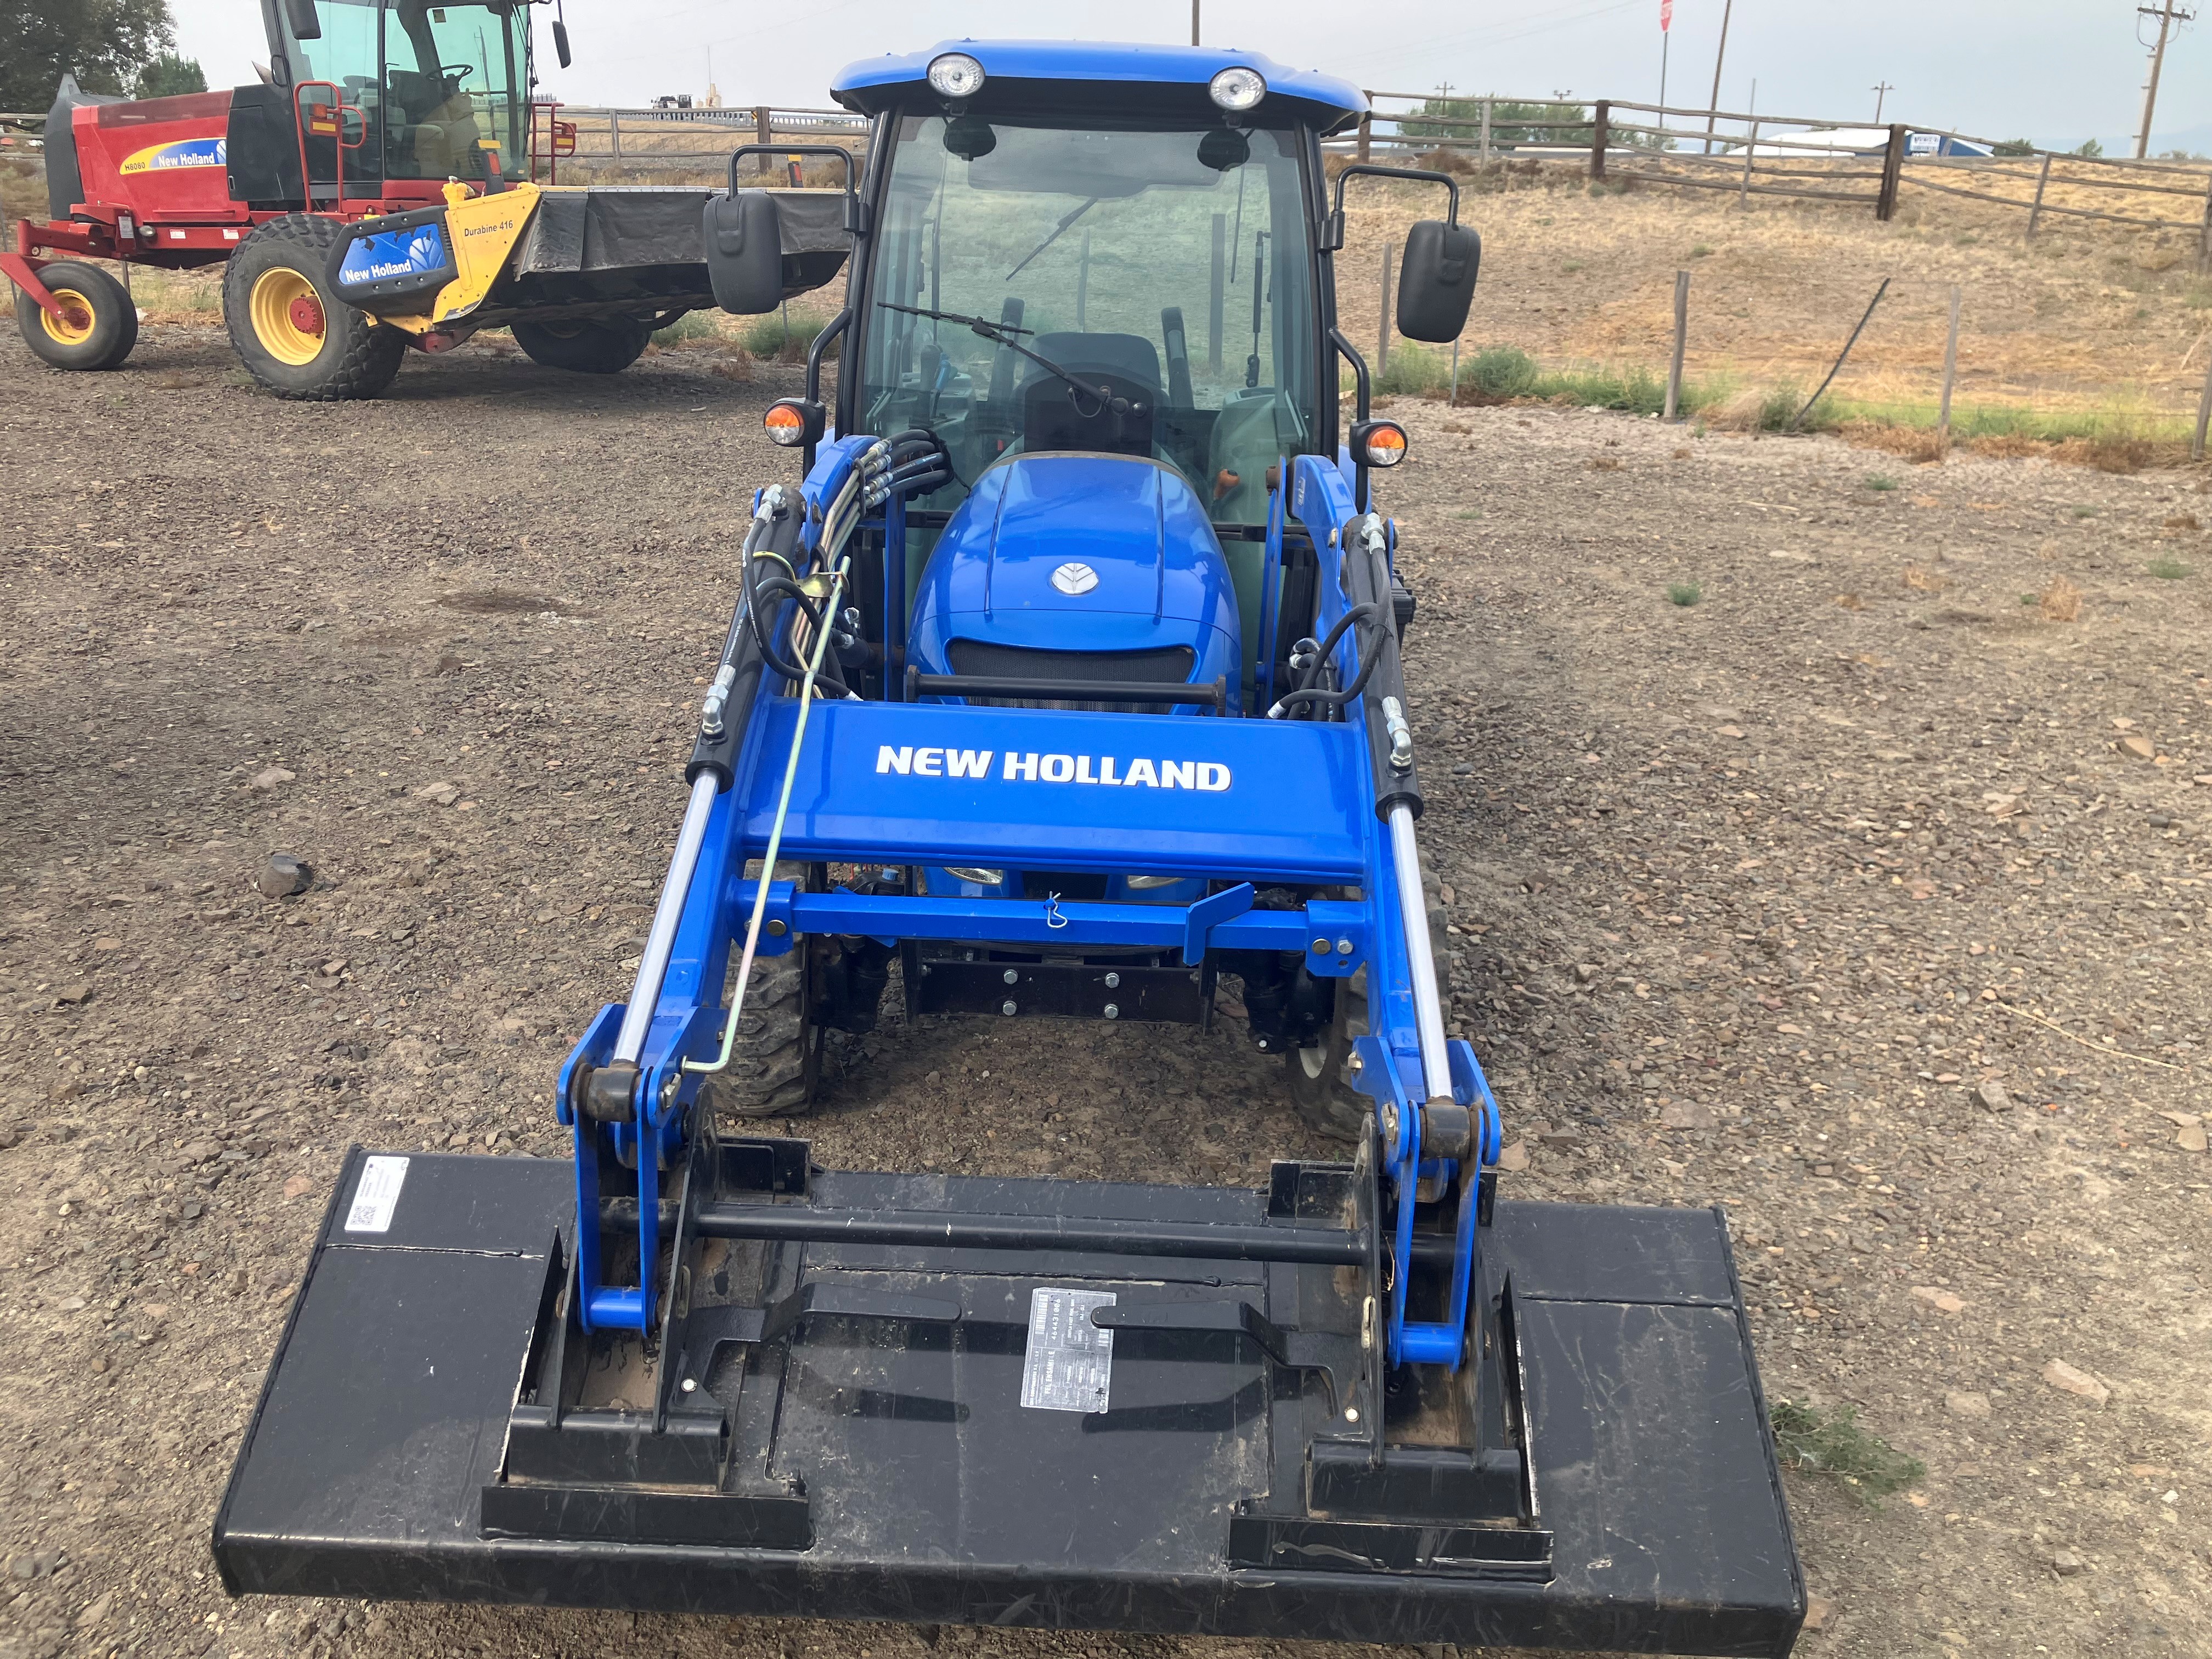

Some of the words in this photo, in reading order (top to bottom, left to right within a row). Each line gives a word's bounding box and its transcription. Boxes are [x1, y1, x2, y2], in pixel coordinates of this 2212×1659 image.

[158, 155, 178, 167] New
[180, 152, 215, 166] Holland
[465, 224, 497, 237] Durabine
[500, 220, 513, 230] 416
[345, 269, 369, 282] New
[370, 258, 411, 278] Holland
[876, 745, 995, 779] NEW
[1003, 751, 1232, 792] HOLLAND
